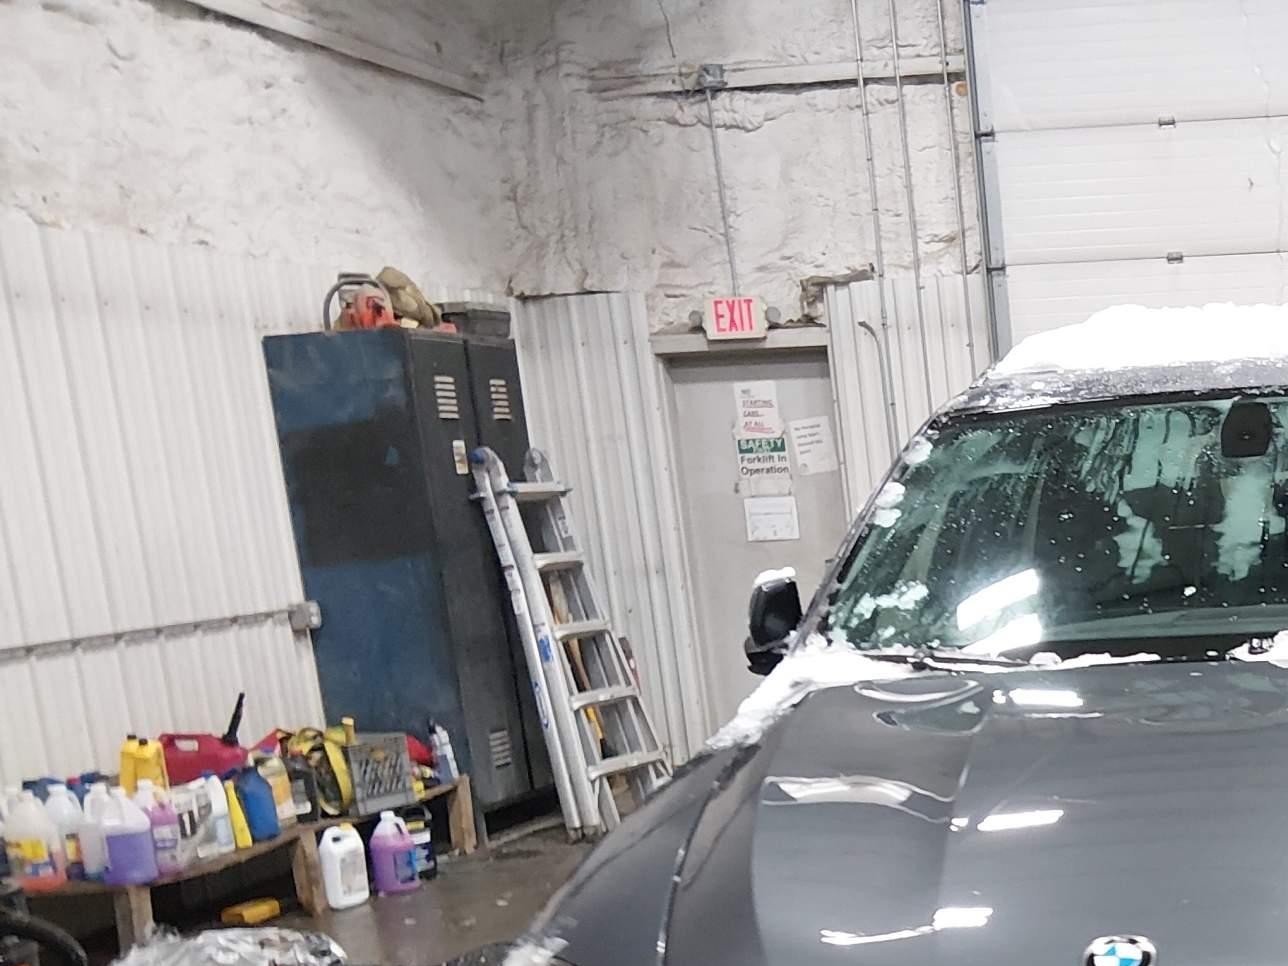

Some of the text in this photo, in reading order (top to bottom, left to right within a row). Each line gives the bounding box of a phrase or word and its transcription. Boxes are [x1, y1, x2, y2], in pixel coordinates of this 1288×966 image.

[713, 298, 753, 332] EXIT
[740, 439, 783, 449] SAFETY
[740, 455, 775, 464] Forklift
[740, 466, 789, 476] Operation
